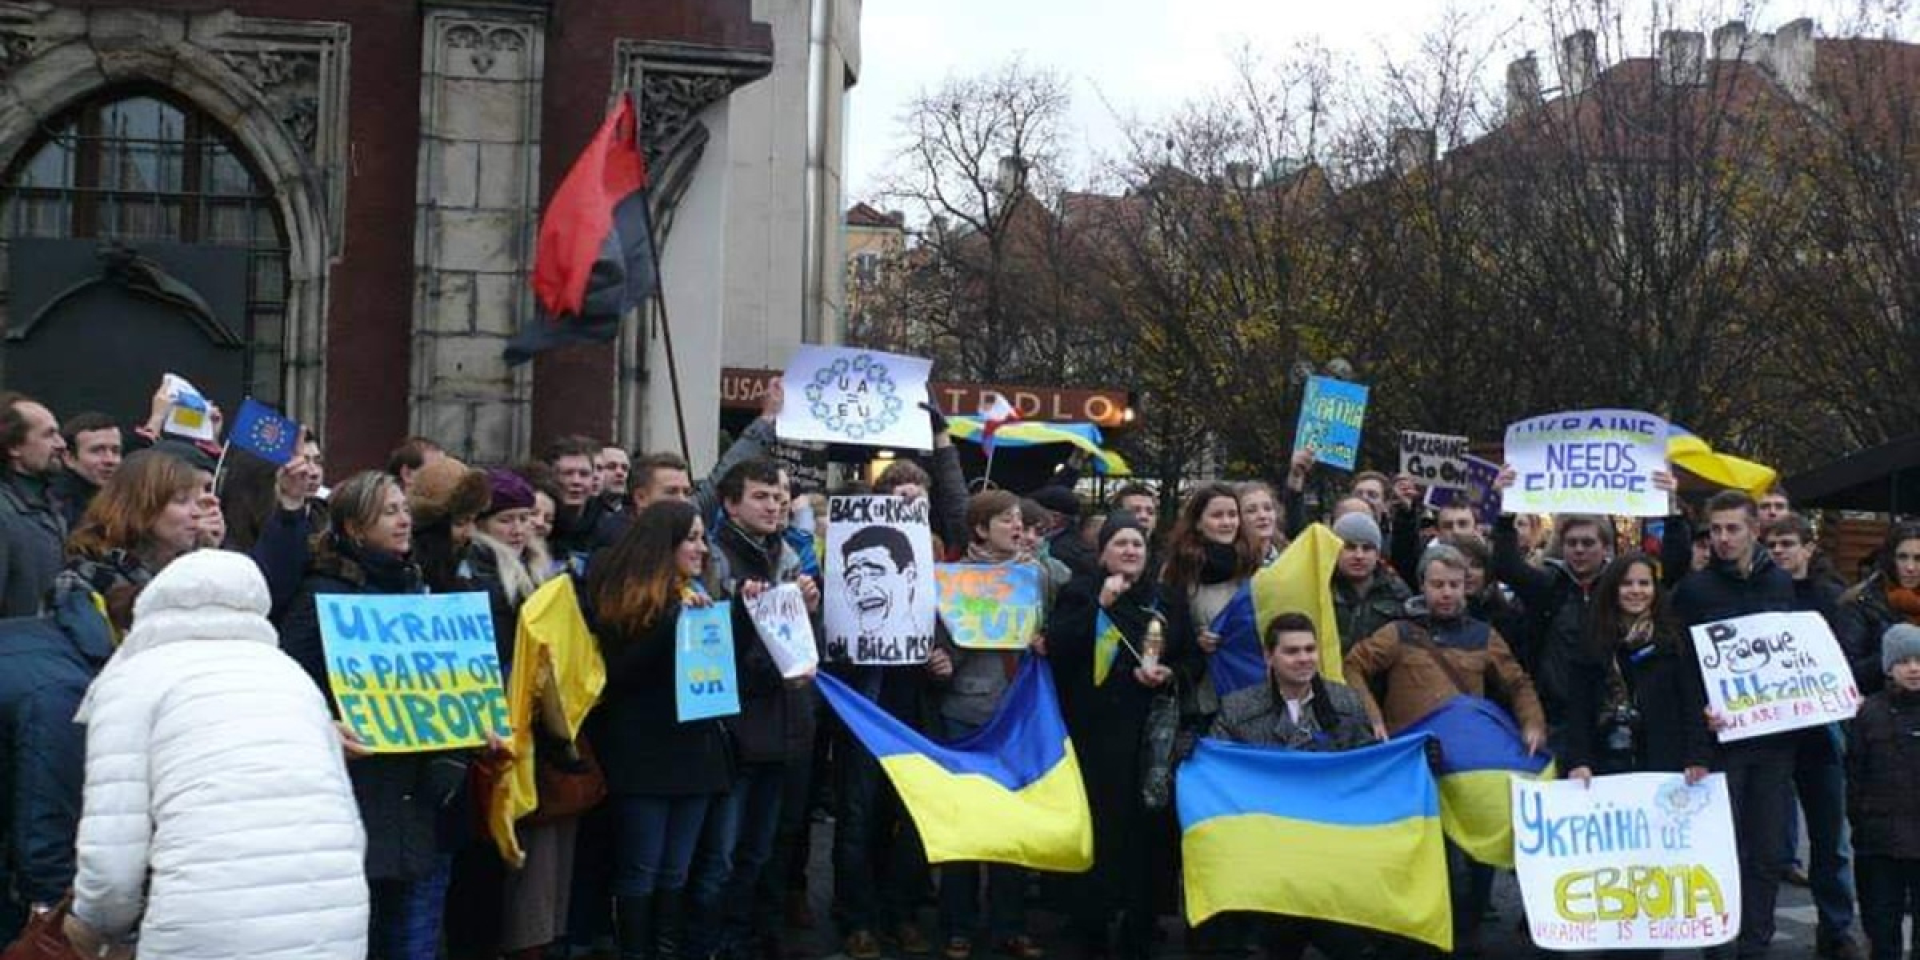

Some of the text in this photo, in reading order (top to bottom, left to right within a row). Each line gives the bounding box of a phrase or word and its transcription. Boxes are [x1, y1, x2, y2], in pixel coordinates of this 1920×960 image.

[838, 403, 869, 417] EU
[1514, 416, 1656, 442] UKRAINE
[1546, 442, 1637, 473] NEEDS
[1524, 471, 1647, 503] EUROPE
[830, 498, 872, 523] BACK
[329, 602, 494, 644] UKRAINE
[336, 650, 500, 690] IS PART OF
[338, 688, 511, 747] EUROPE
